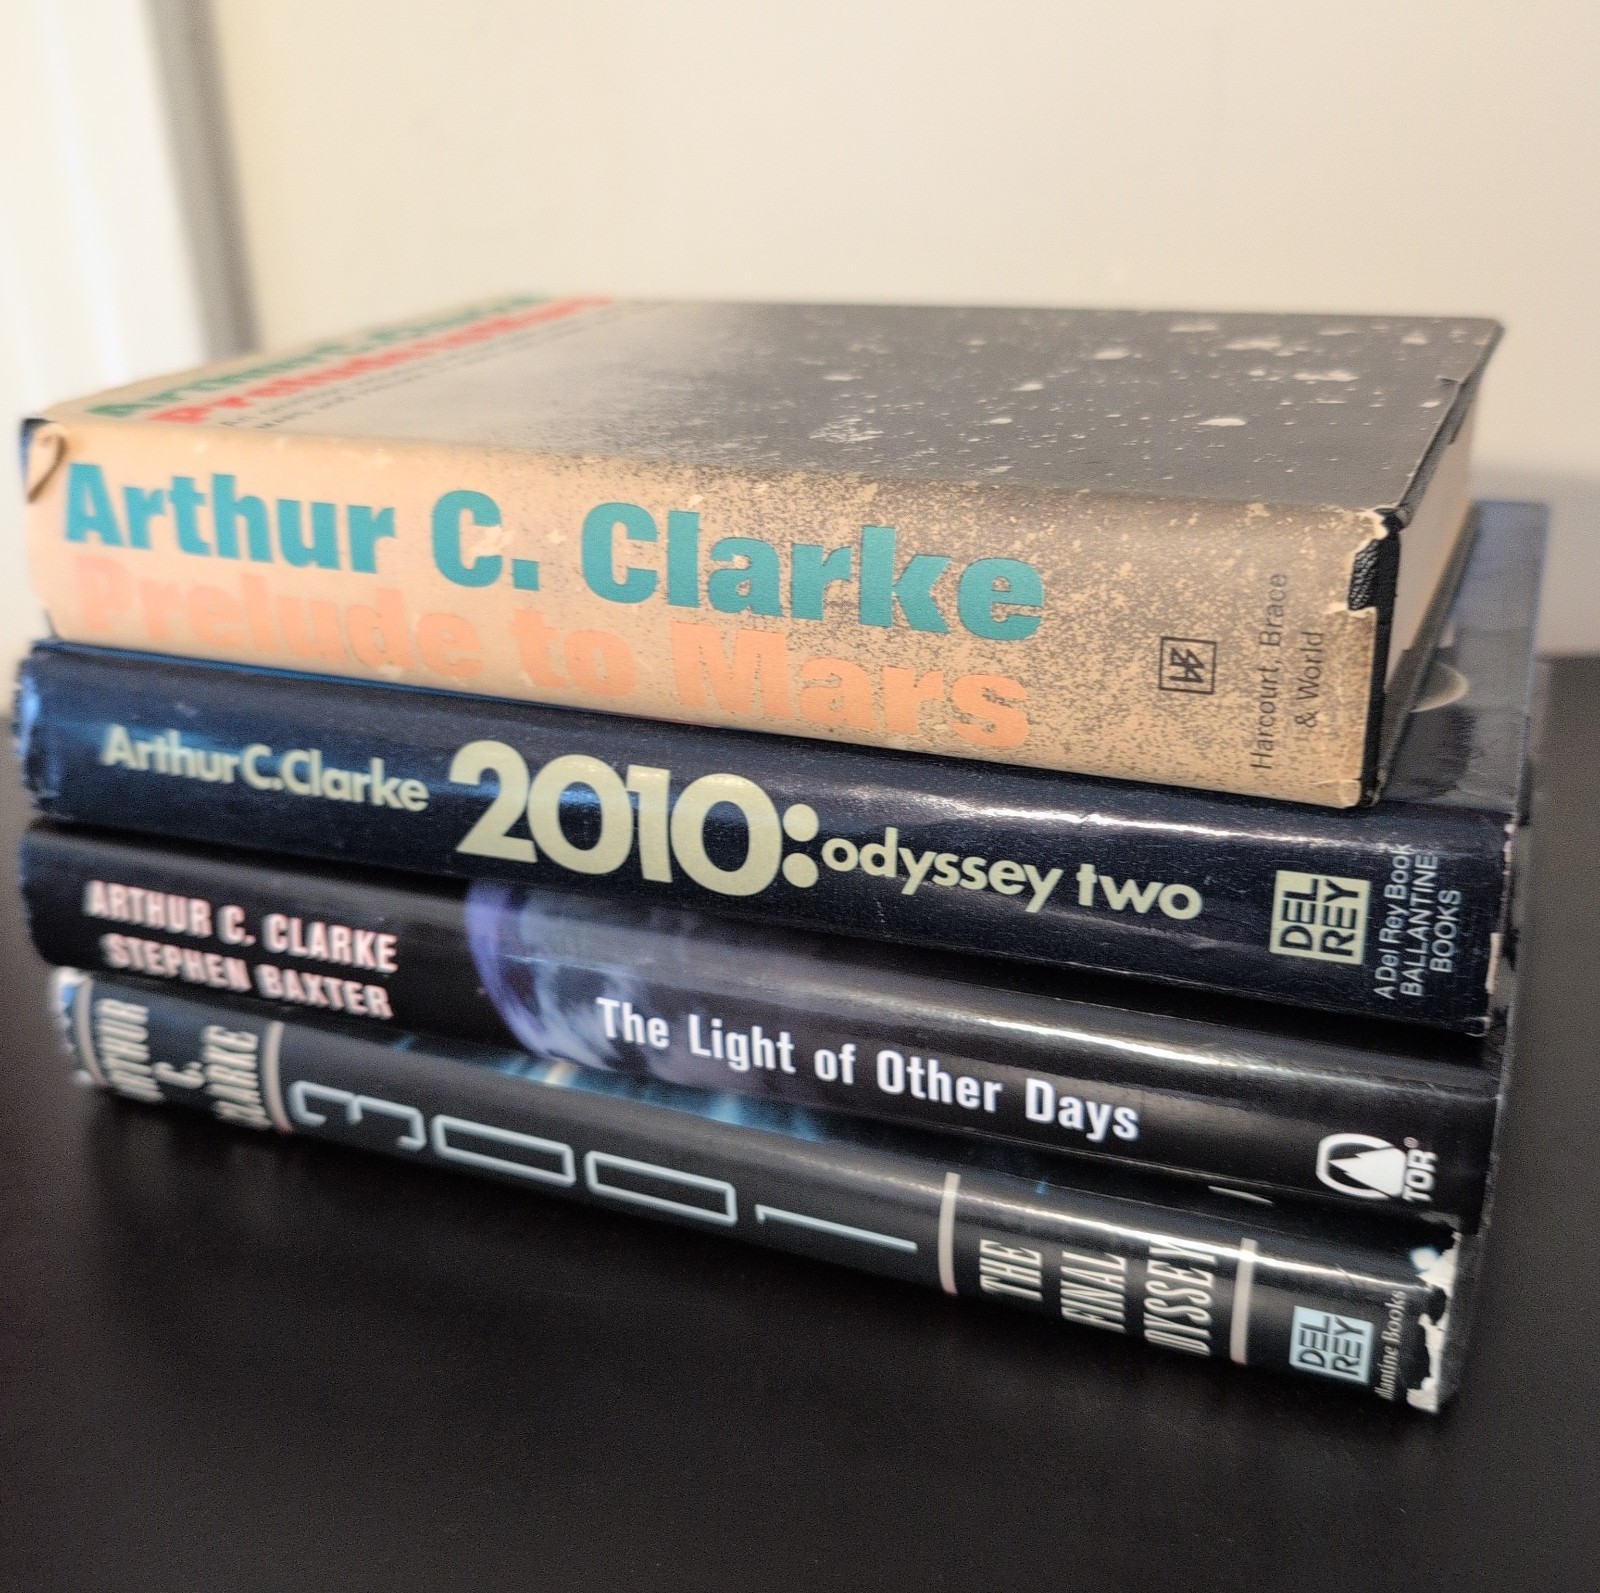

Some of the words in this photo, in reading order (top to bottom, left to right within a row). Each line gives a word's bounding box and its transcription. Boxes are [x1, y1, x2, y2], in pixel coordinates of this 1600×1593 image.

[64, 463, 395, 574] Arthur
[432, 490, 539, 591] C.
[580, 502, 1045, 641] Clarke
[1258, 573, 1288, 649] Brace
[73, 555, 485, 679] Prelude
[509, 609, 638, 697] to
[669, 620, 1030, 748] Mars
[1297, 631, 1325, 701] World
[1250, 658, 1283, 770] Harcourt,
[1295, 711, 1317, 728] &
[448, 740, 820, 897] 2010:
[821, 826, 1062, 913] odyssey
[1076, 863, 1202, 921] two
[1384, 843, 1413, 900] Book
[84, 880, 213, 938] ARTHUR
[217, 904, 256, 947] C.
[263, 913, 398, 974] CLARKE
[1278, 878, 1319, 951] DEL
[1319, 878, 1360, 957] REY
[1379, 903, 1410, 945] Rey
[1400, 854, 1439, 997] BALLANTINE
[1429, 889, 1462, 973] BOOKS
[101, 933, 252, 992] STEPHEN
[255, 964, 394, 1020] BAXTER
[1373, 985, 1397, 1000] A
[1375, 948, 1401, 982] Del
[596, 998, 670, 1050] The
[688, 1013, 796, 1075] Light
[814, 1043, 857, 1086] of
[876, 1049, 1002, 1115] Other
[1025, 1078, 1140, 1142] Days
[979, 1238, 1043, 1301] THE
[1060, 1250, 1127, 1333] FINAL
[1298, 1315, 1332, 1369] DEL
[1331, 1315, 1366, 1377] REY
[1381, 1290, 1408, 1344] Books
